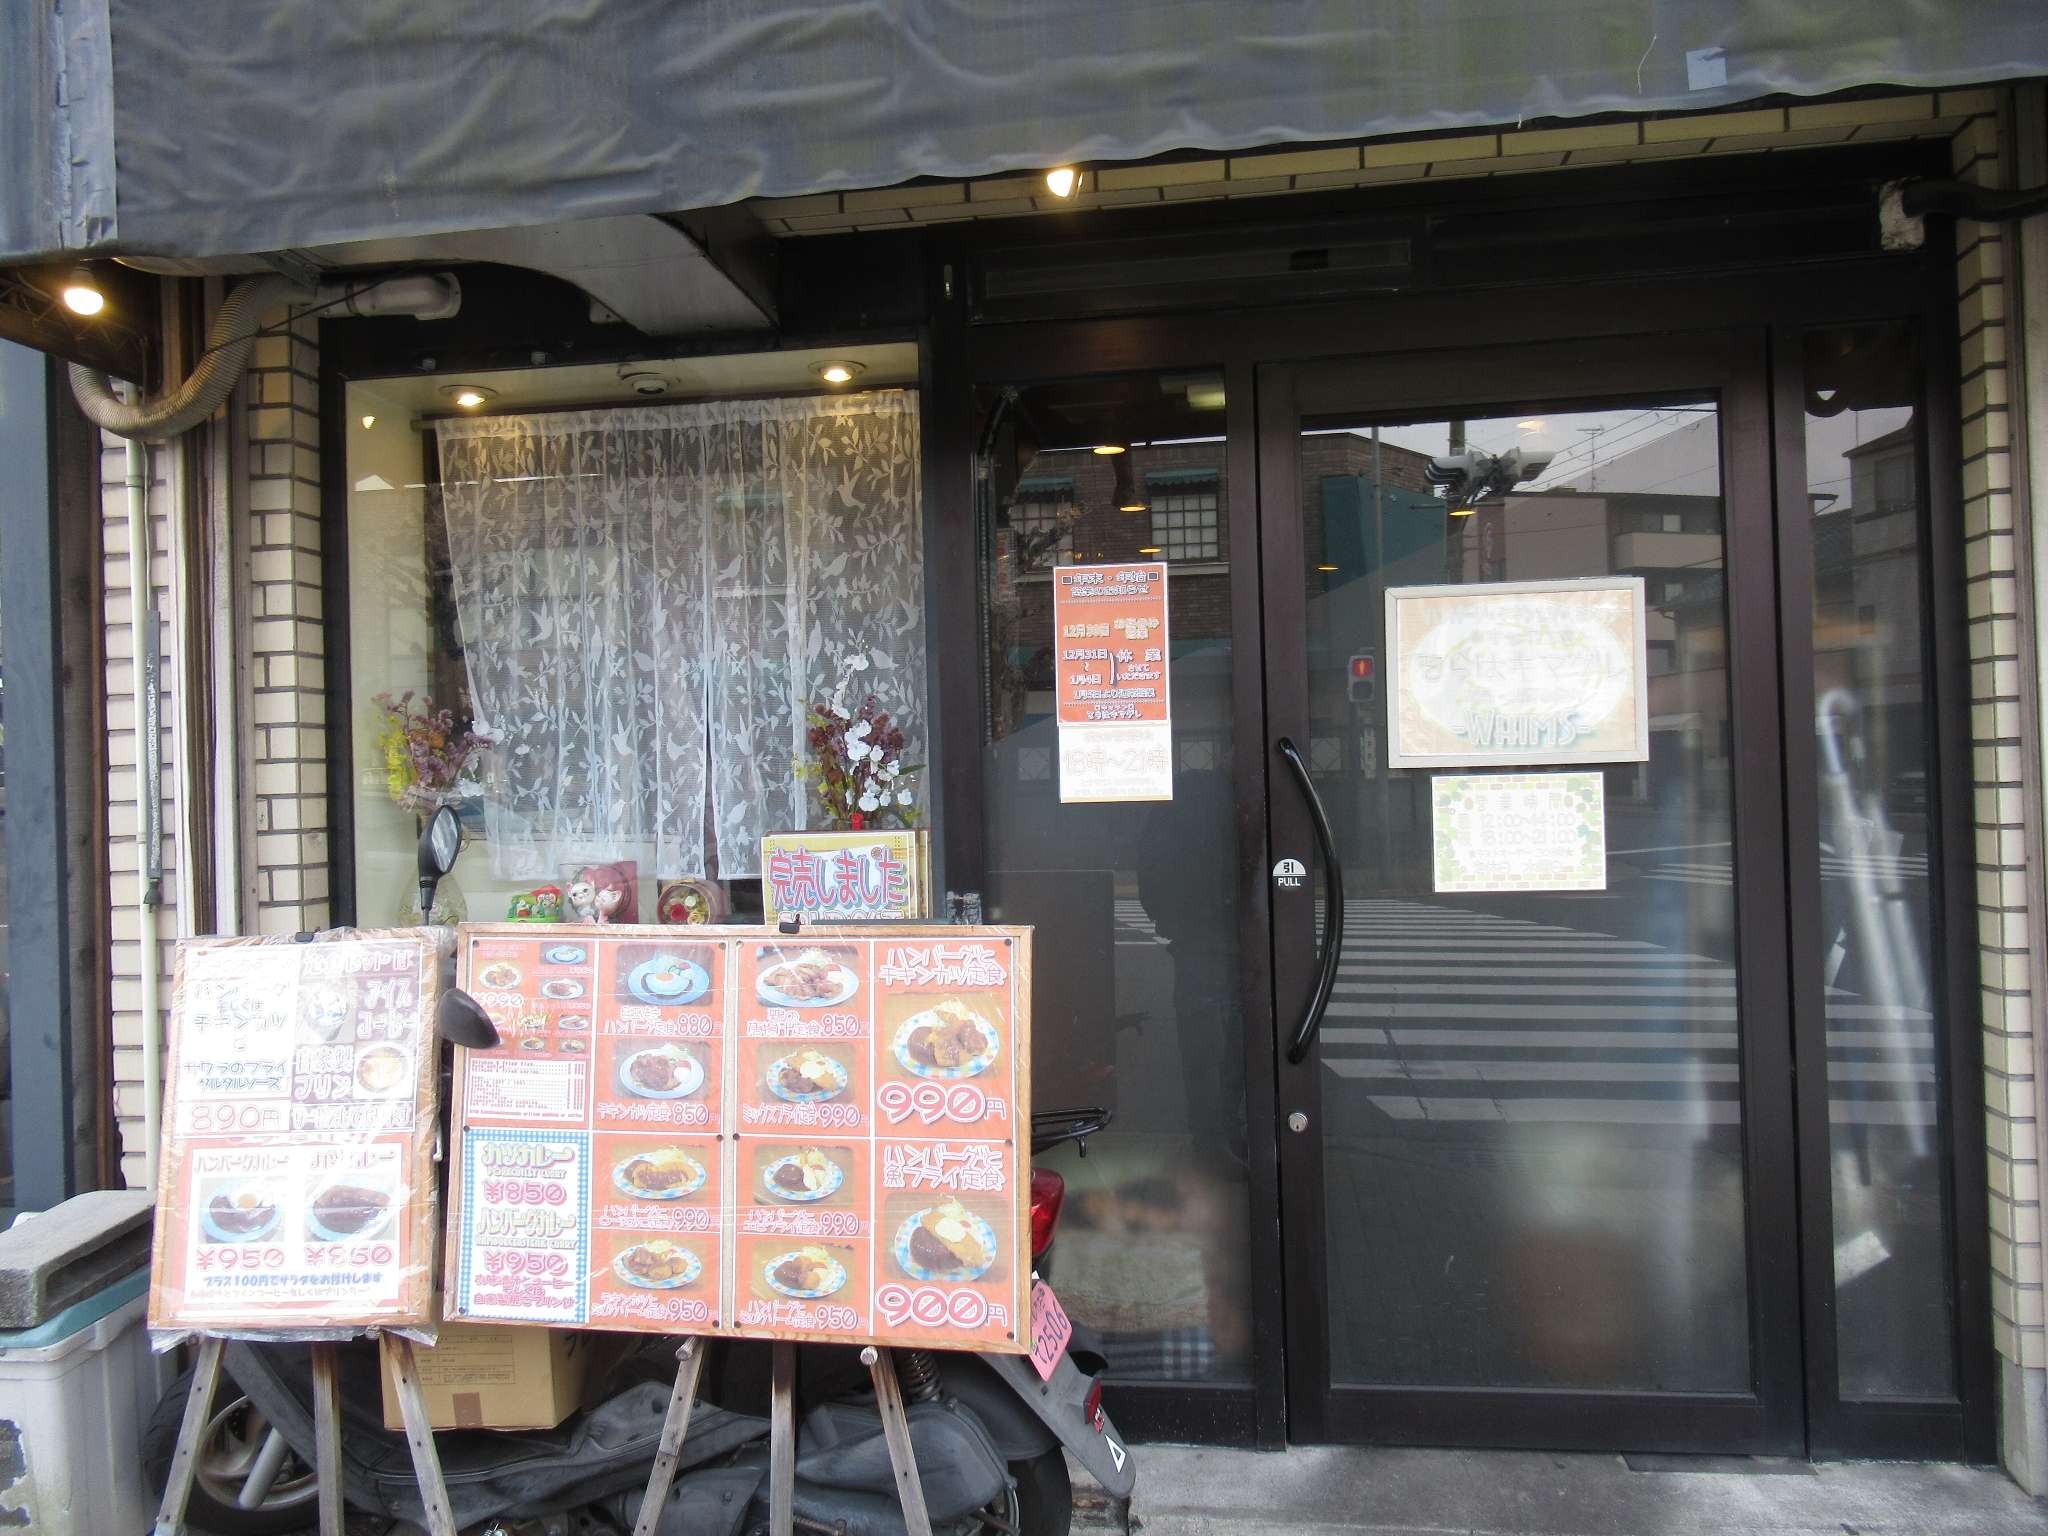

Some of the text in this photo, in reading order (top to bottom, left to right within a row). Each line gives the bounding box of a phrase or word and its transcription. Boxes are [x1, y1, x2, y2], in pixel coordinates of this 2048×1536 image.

[1278, 877, 1301, 887] PULL
[879, 964, 1007, 987] チキンカツ定食
[821, 1014, 861, 1037] 850
[672, 1102, 711, 1125] 850
[878, 1081, 1007, 1125] 990円
[191, 1104, 280, 1131] 890円
[819, 1103, 861, 1128] 990
[884, 1144, 1003, 1168] ハンバーグと
[483, 1181, 567, 1205] ¥850
[820, 1211, 860, 1236] 990
[195, 1248, 286, 1270] ¥950
[484, 1251, 569, 1276] ¥950
[668, 1297, 709, 1321] 950
[815, 1304, 858, 1330] 950
[875, 1284, 1008, 1330] 900円
